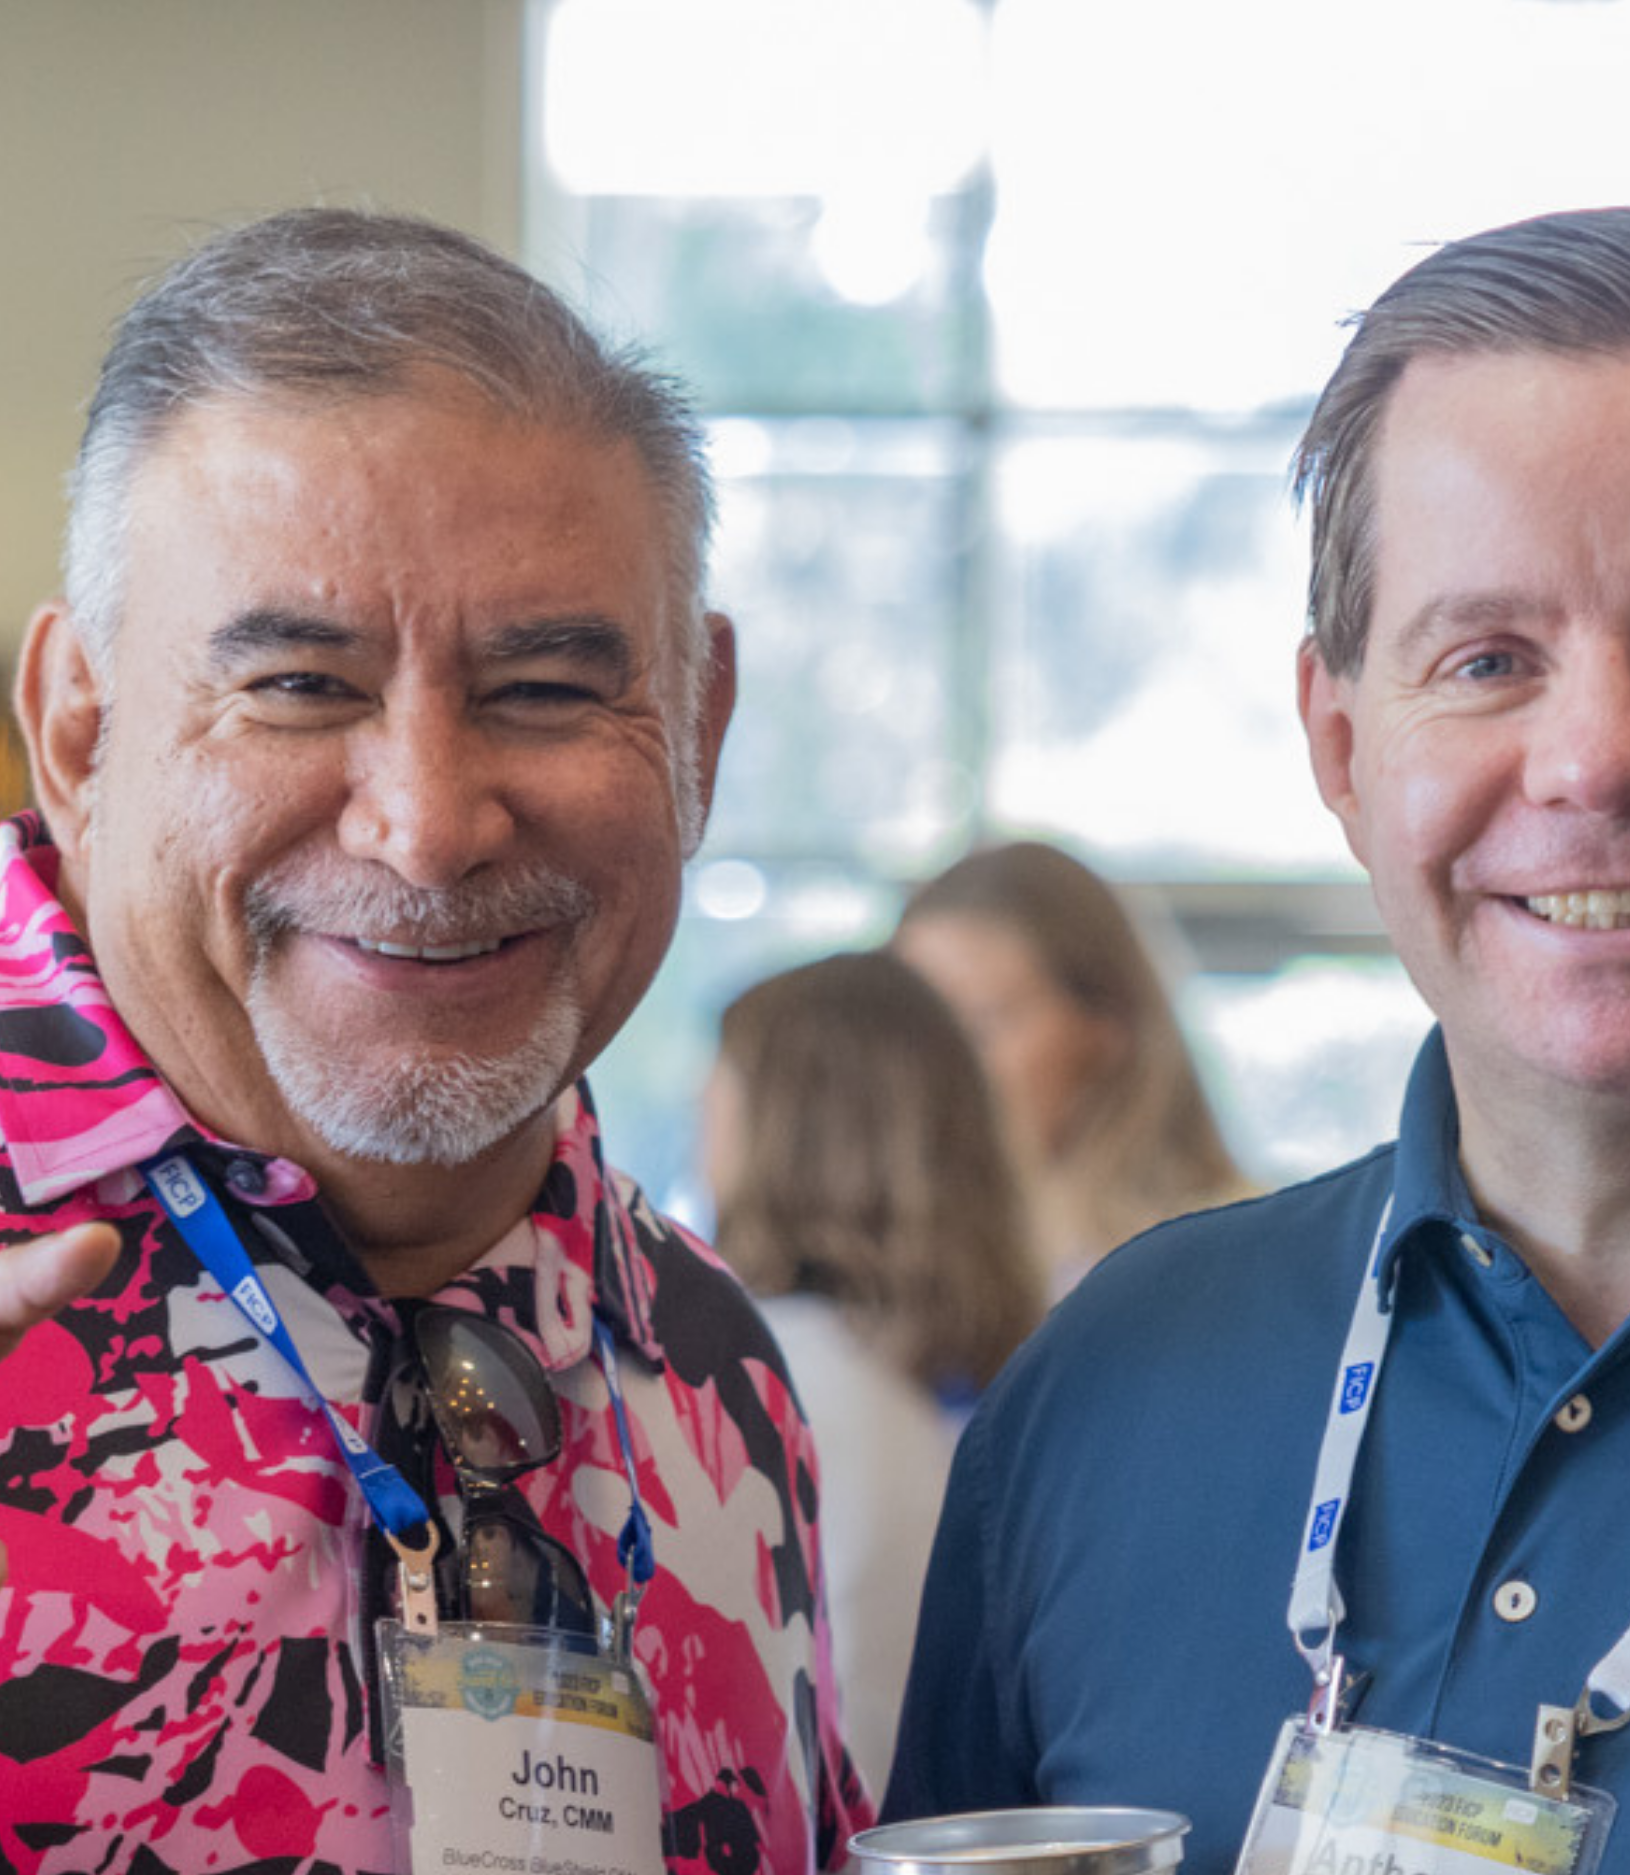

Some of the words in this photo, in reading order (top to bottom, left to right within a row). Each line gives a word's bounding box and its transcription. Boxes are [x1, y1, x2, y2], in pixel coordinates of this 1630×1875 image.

[159, 1162, 196, 1208] FICP
[239, 1283, 273, 1326] FICP
[512, 1748, 599, 1796] John
[499, 1796, 559, 1829] Cruz,
[563, 1804, 615, 1834] CMM
[443, 1848, 526, 1873] BlueCross
